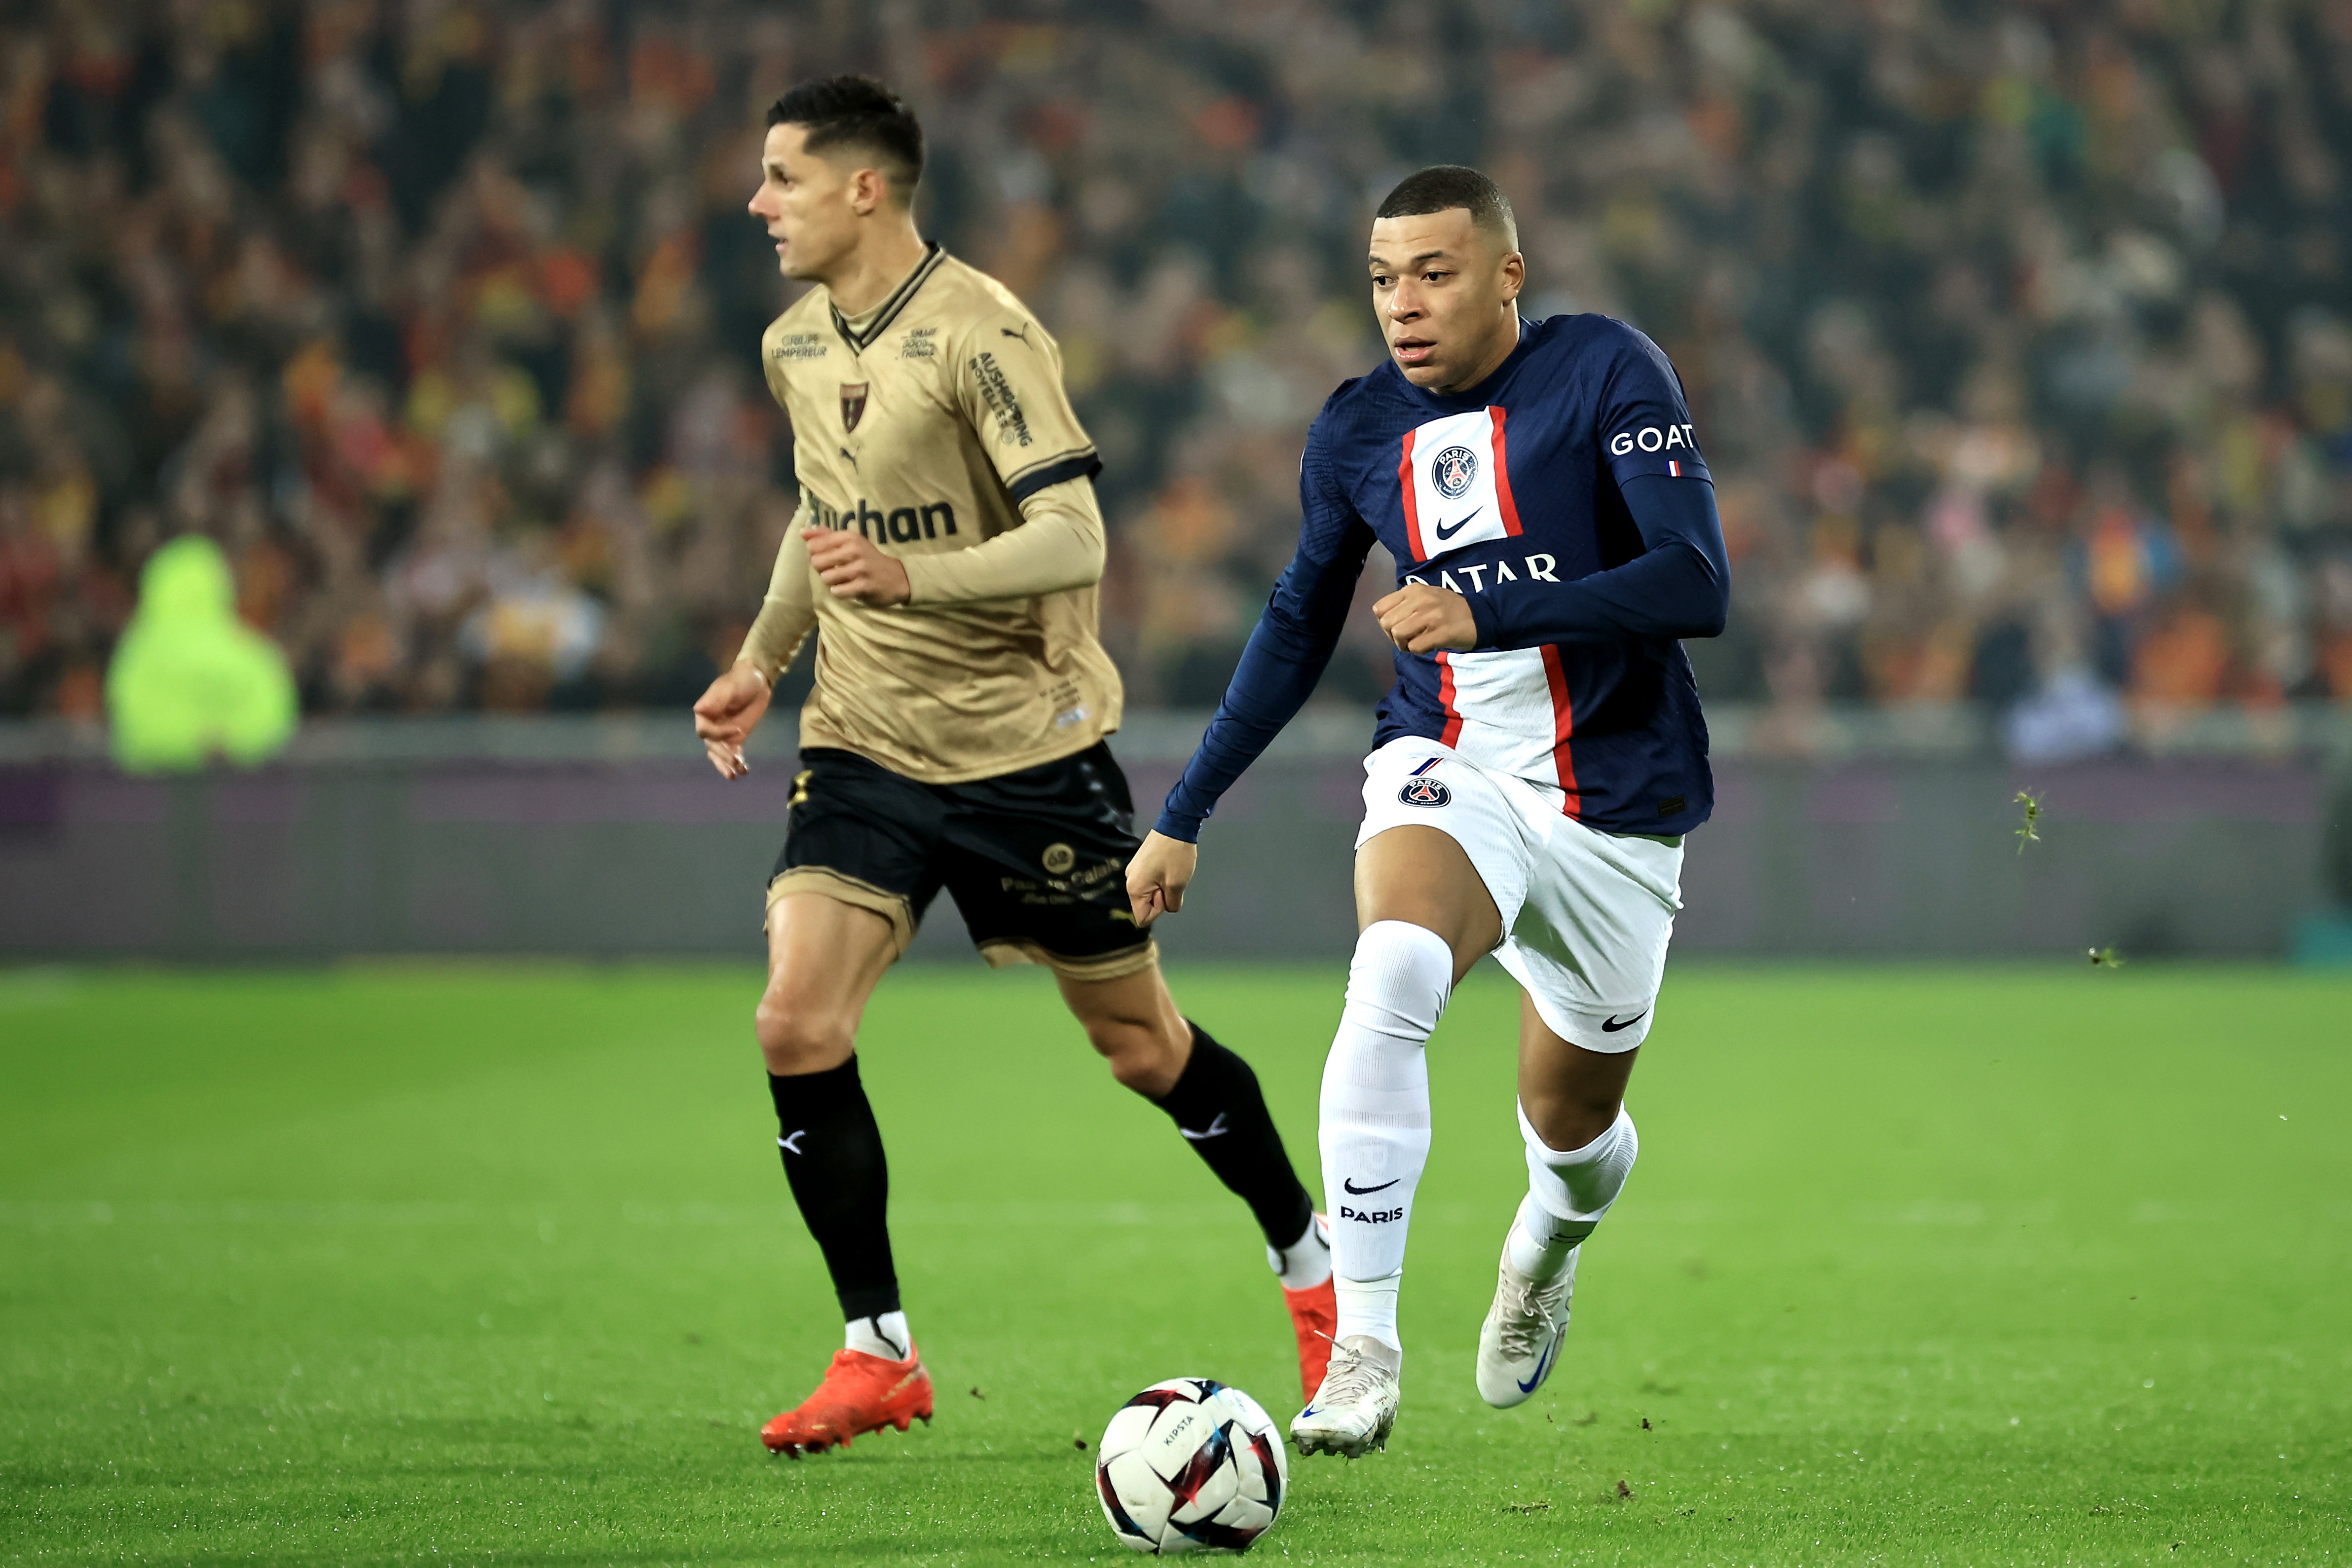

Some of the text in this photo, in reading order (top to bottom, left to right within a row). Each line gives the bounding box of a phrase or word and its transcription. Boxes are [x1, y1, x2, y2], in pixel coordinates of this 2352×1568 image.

[771, 346, 826, 358] LEMPEREUR
[979, 352, 1033, 447] AUSHOPPING
[1611, 424, 1693, 455] GOAT
[1439, 450, 1470, 464] PARIS
[1409, 780, 1443, 790] PARIS
[1341, 1206, 1403, 1224] PARIS
[1163, 1416, 1194, 1446] KIPSTA
